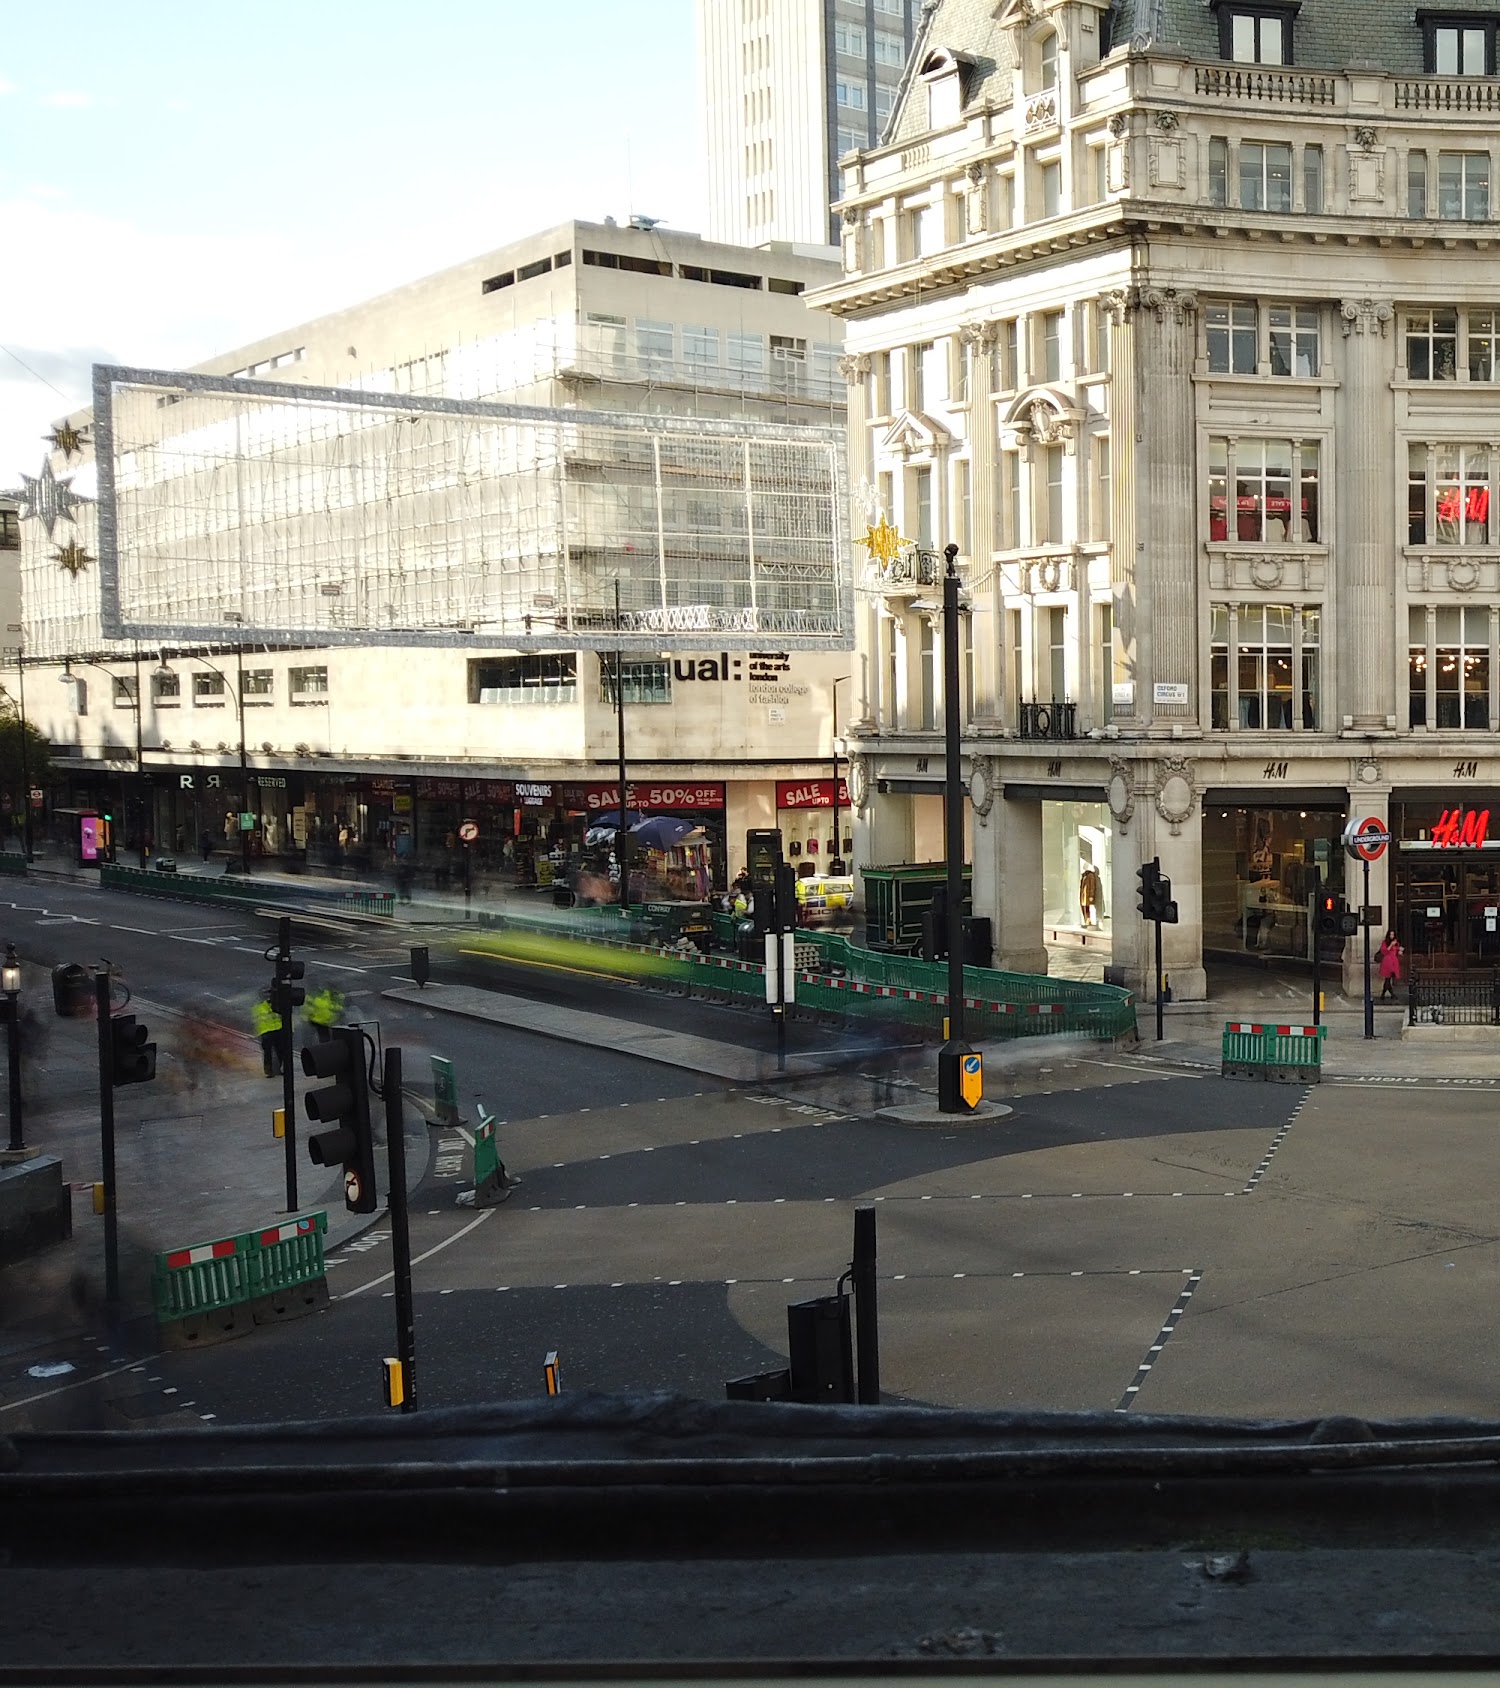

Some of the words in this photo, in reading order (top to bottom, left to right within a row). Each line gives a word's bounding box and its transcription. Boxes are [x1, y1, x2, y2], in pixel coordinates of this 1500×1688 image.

[749, 662, 758, 671] of
[759, 662, 773, 671] the
[774, 662, 790, 671] arts
[749, 672, 778, 681] london
[749, 683, 778, 693] london
[778, 684, 808, 695] college
[749, 695, 758, 704] of
[759, 694, 789, 704] fashion
[1263, 762, 1288, 779] H&M
[1453, 762, 1477, 778] H&M
[258, 776, 286, 788] RESERVED
[515, 783, 552, 797] SOUVENIRS
[649, 788, 695, 804] 50%
[695, 789, 717, 798] OFF
[785, 783, 820, 806] SALE
[587, 787, 636, 809] SALE
[1431, 809, 1490, 849] H&M
[1353, 833, 1390, 844] UNDERGROUND
[340, 1230, 393, 1253] LOOK
